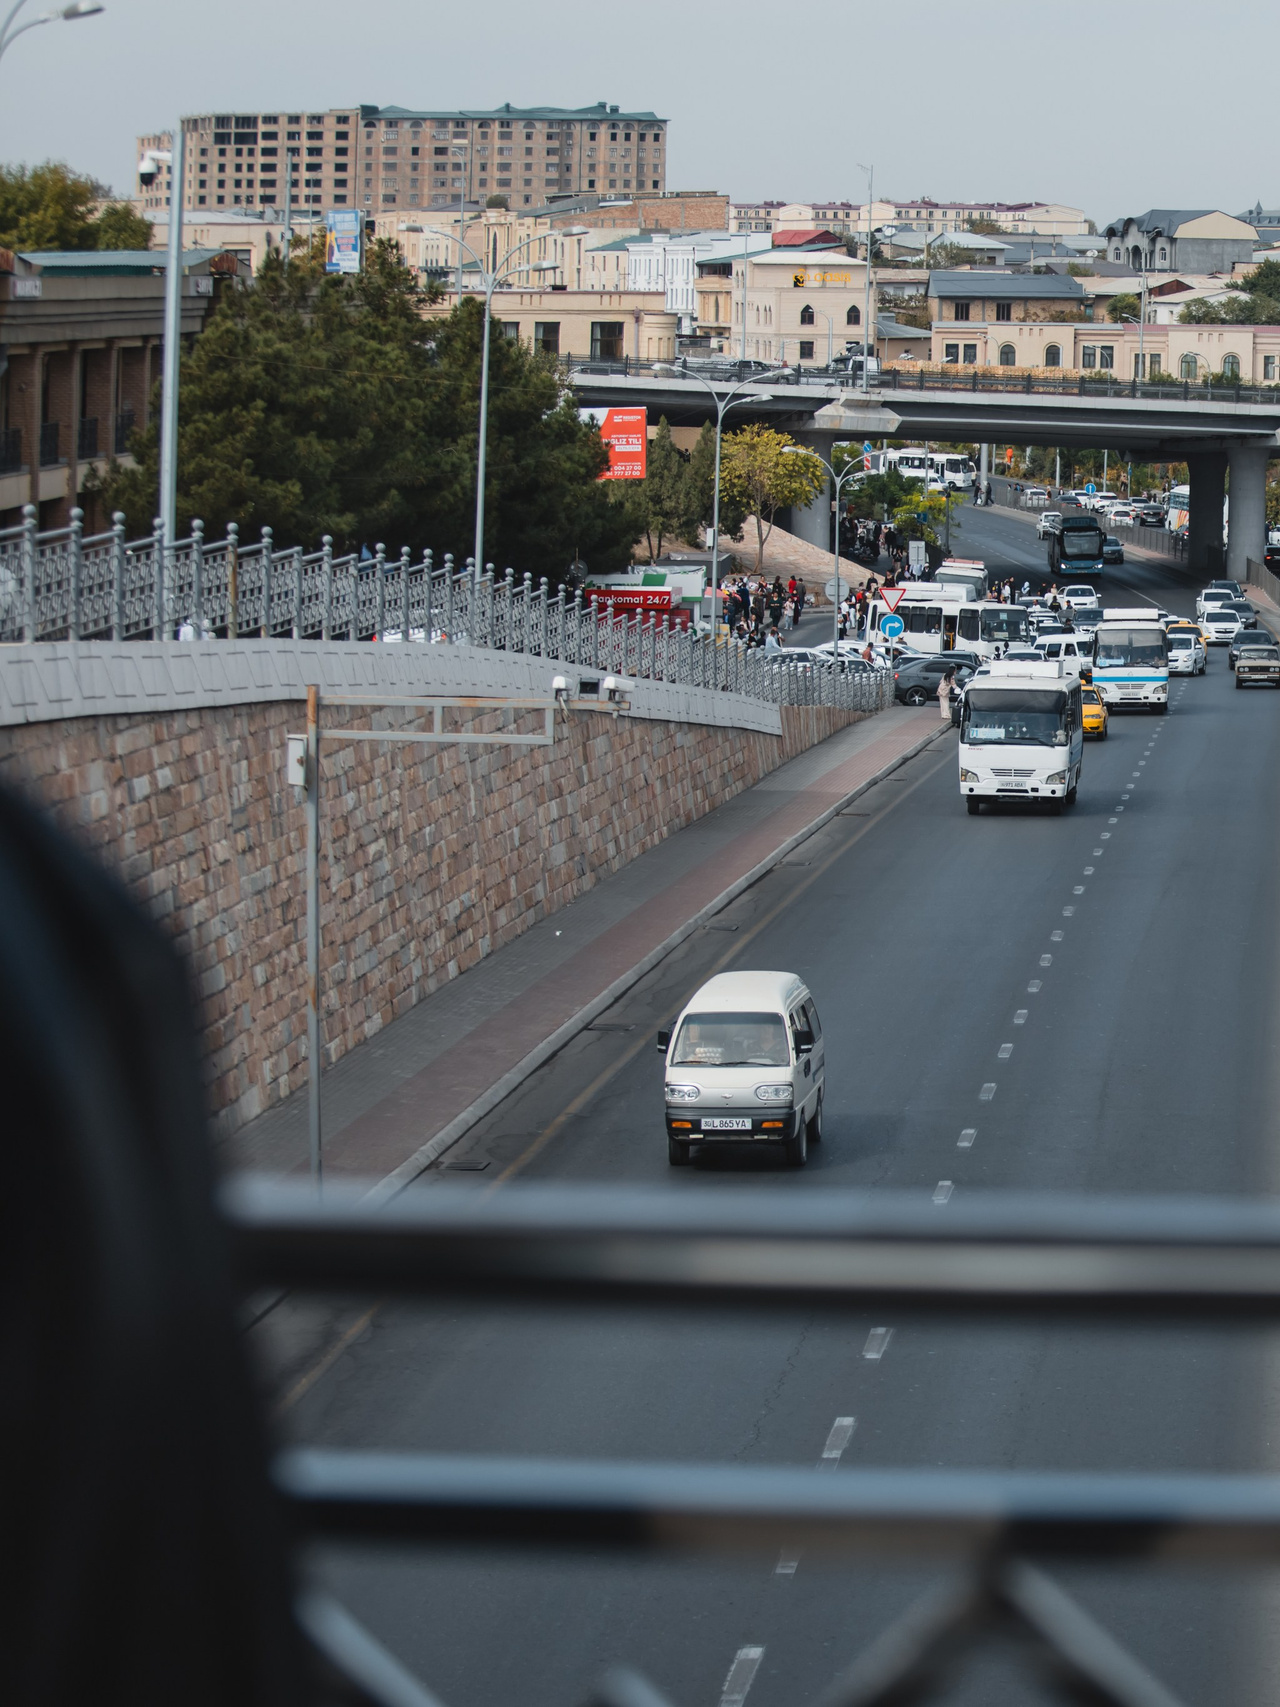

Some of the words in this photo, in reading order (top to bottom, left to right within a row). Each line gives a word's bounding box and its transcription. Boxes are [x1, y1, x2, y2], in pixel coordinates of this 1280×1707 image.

[814, 271, 851, 282] oasis
[592, 594, 644, 604] ankomat
[646, 595, 670, 604] 24/7
[970, 729, 979, 737] 71
[719, 1120, 734, 1128] 865
[735, 1120, 746, 1128] YA
